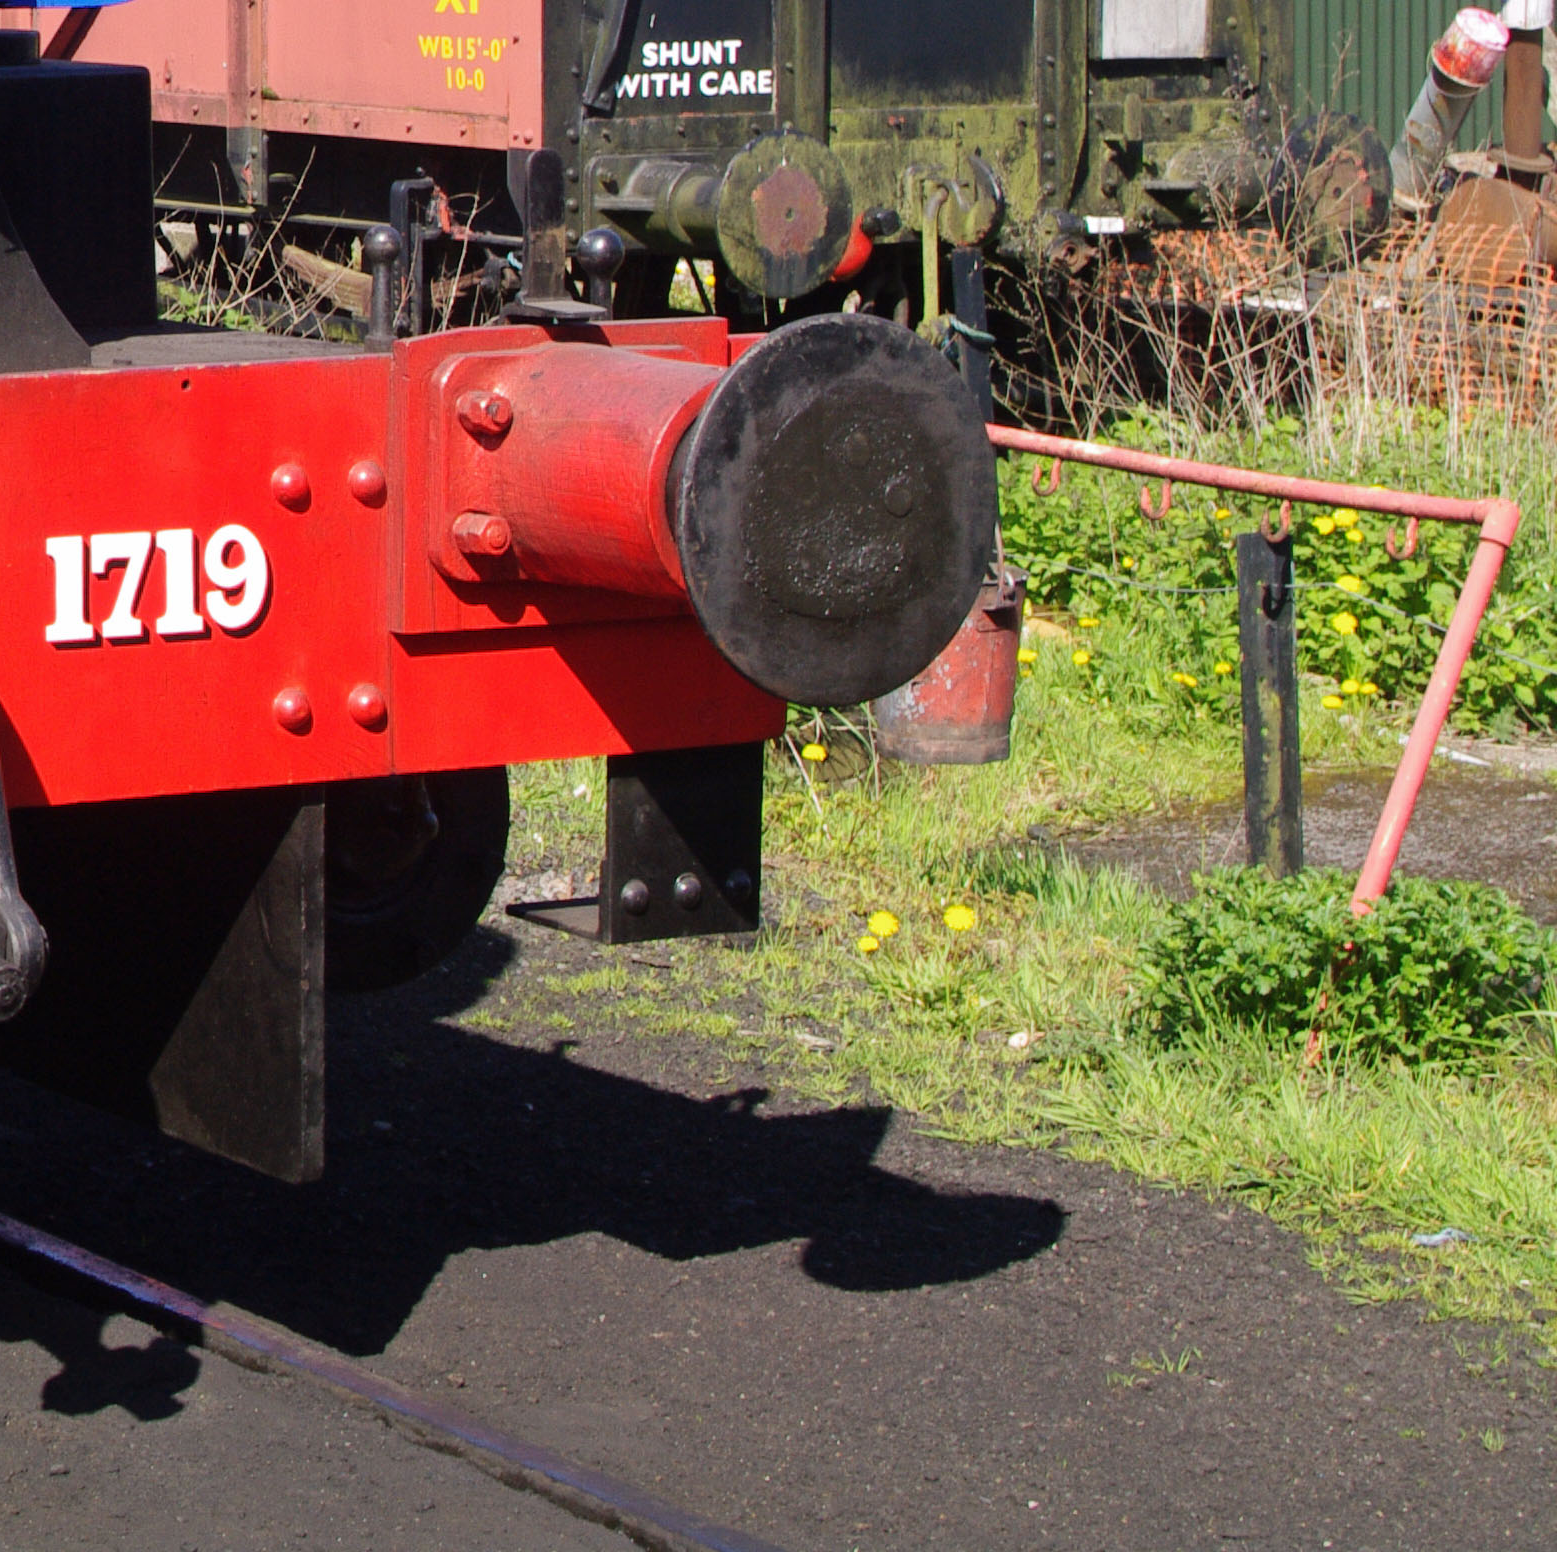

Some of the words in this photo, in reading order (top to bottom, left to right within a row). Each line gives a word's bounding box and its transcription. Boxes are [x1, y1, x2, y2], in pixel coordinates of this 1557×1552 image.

[641, 39, 743, 68] SHUNT
[446, 65, 485, 91] 10-0
[615, 71, 691, 99] WITH
[699, 68, 774, 97] CARE
[44, 522, 273, 648] 1719
